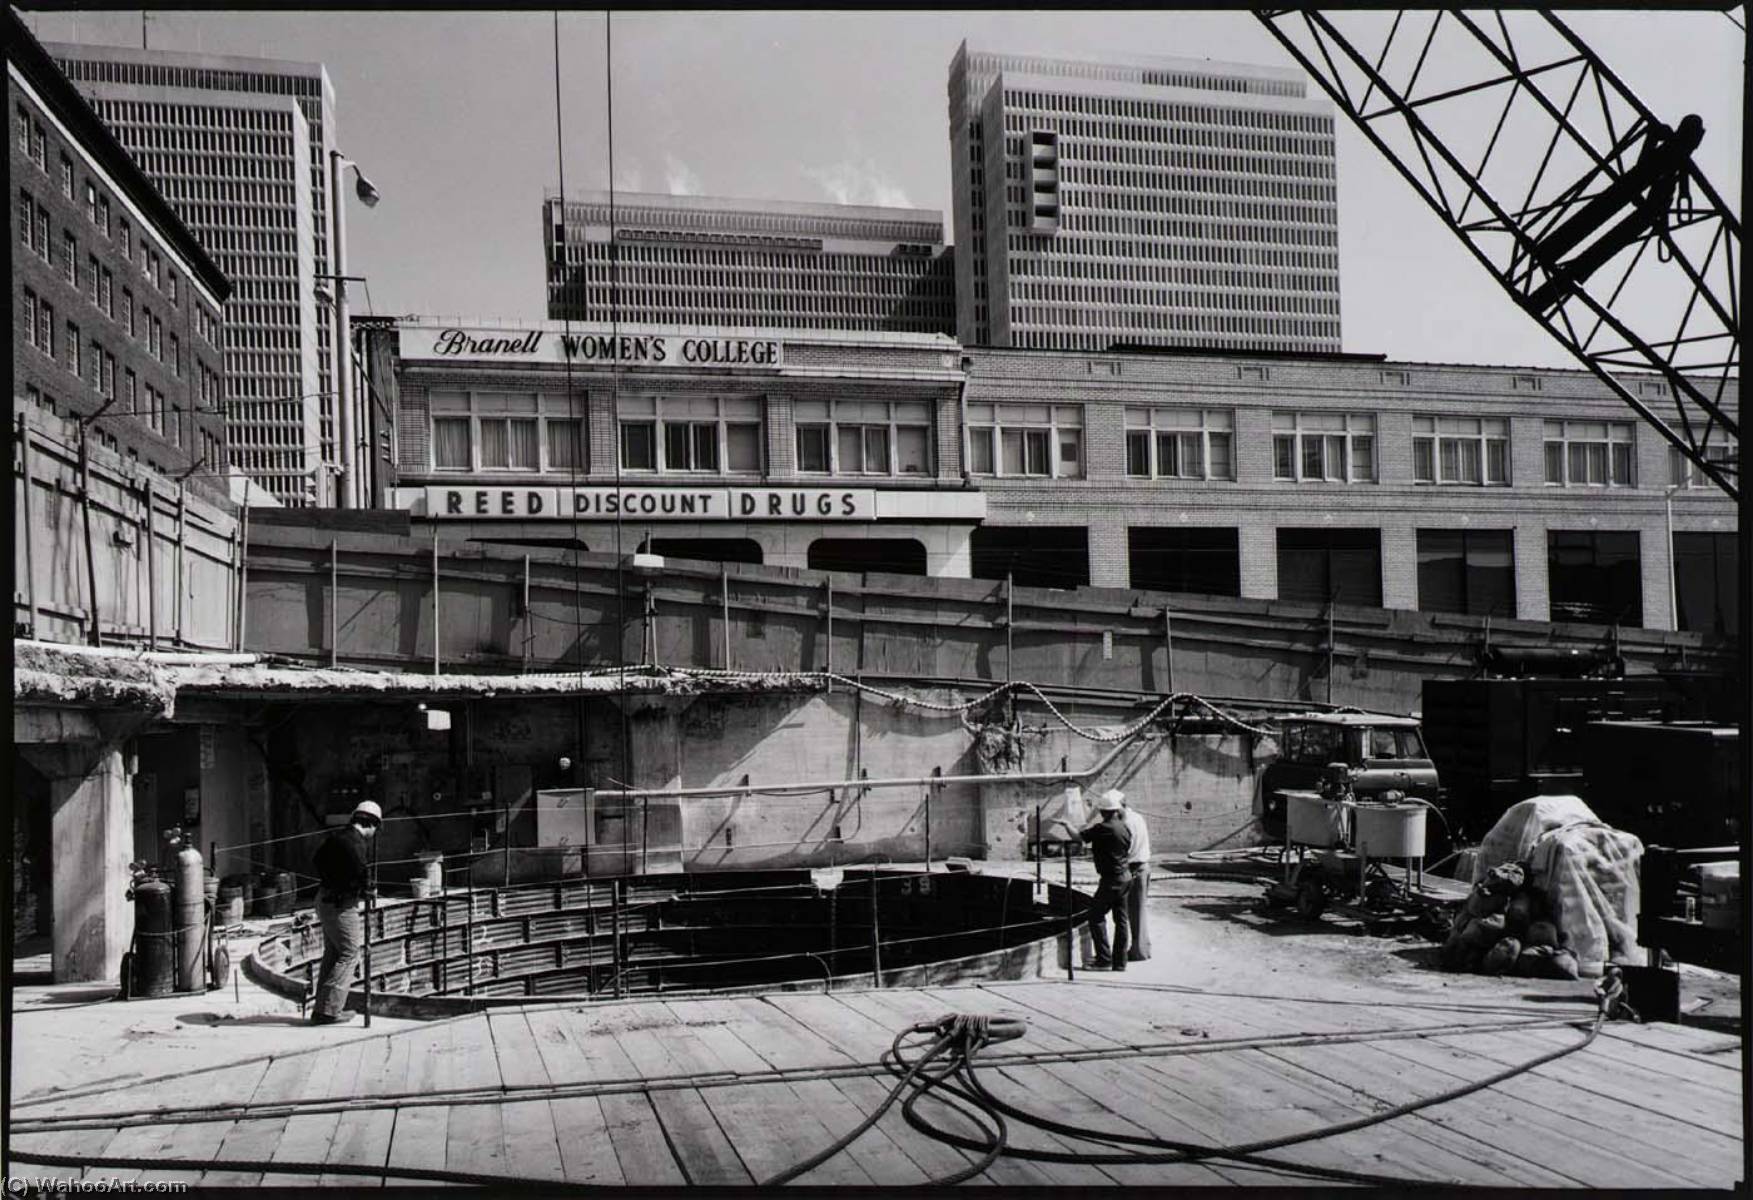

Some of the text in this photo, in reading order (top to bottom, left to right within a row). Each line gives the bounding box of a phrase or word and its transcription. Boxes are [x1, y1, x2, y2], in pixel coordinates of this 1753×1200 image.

[433, 329, 778, 364] Branell WOMEN'S COLLEGE
[447, 491, 855, 516] REED DISCOUNT DRUGS
